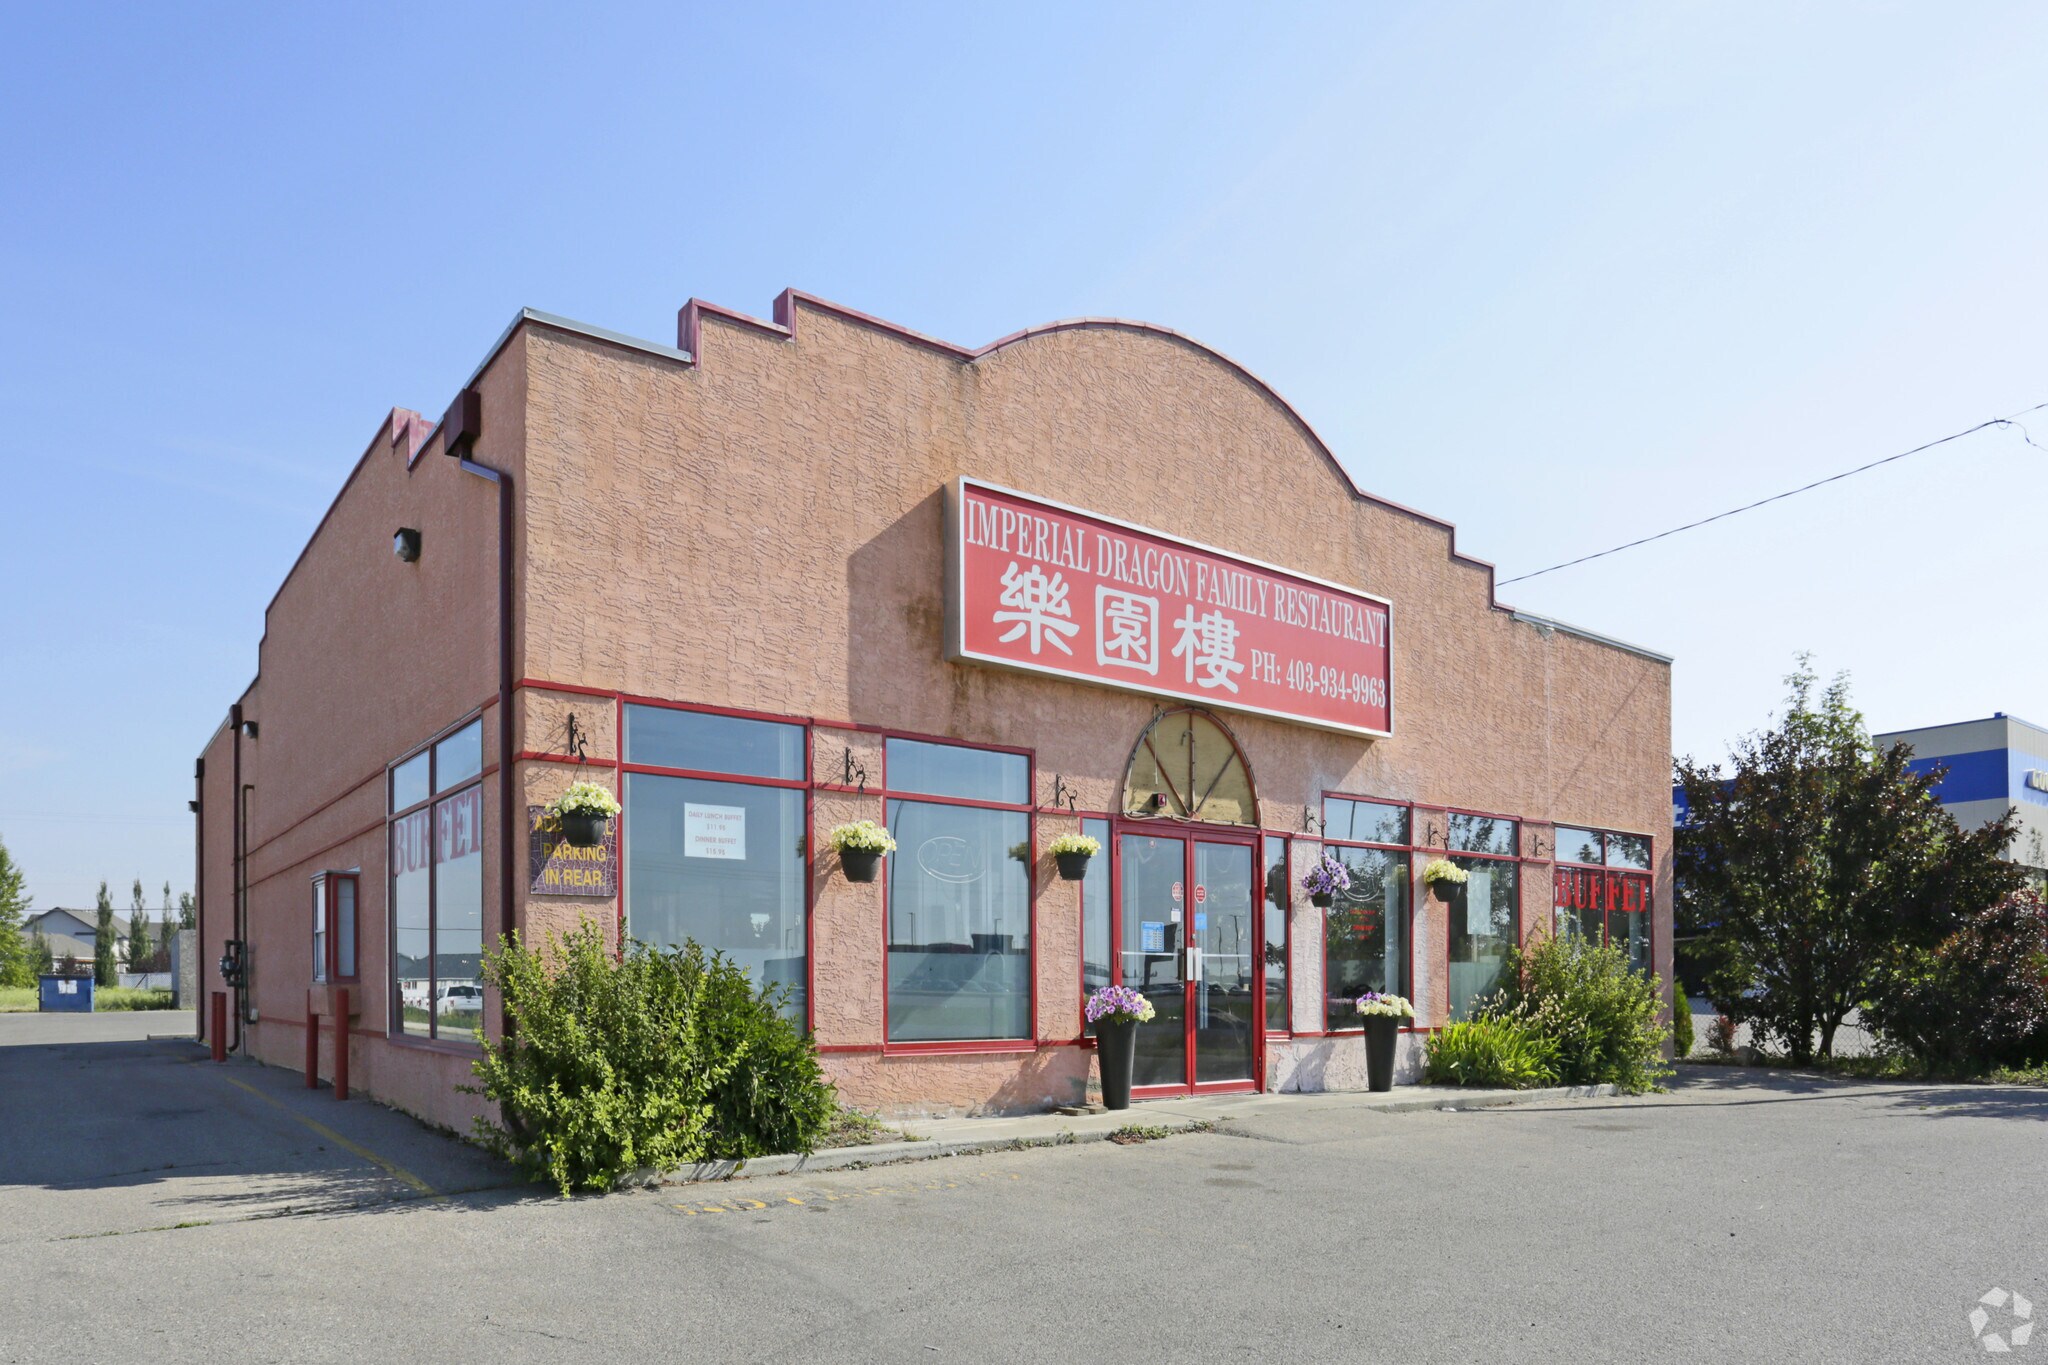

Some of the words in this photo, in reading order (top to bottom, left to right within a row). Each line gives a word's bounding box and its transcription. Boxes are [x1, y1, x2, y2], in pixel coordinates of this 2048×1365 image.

[966, 498, 1091, 573] IMPERIAL
[1096, 534, 1190, 598] DRAGON
[1195, 561, 1270, 618] FAMILY
[1273, 583, 1387, 648] RESTAURANT
[992, 560, 1245, 694] 樂園樓
[1250, 648, 1281, 685] PH:
[1285, 658, 1387, 708] 403-934-9963
[394, 785, 481, 876] BUFFET
[704, 812, 723, 820] LUNCH
[543, 843, 607, 862] PARKING
[545, 868, 560, 885] IN
[1554, 868, 1649, 912] BUFFET
